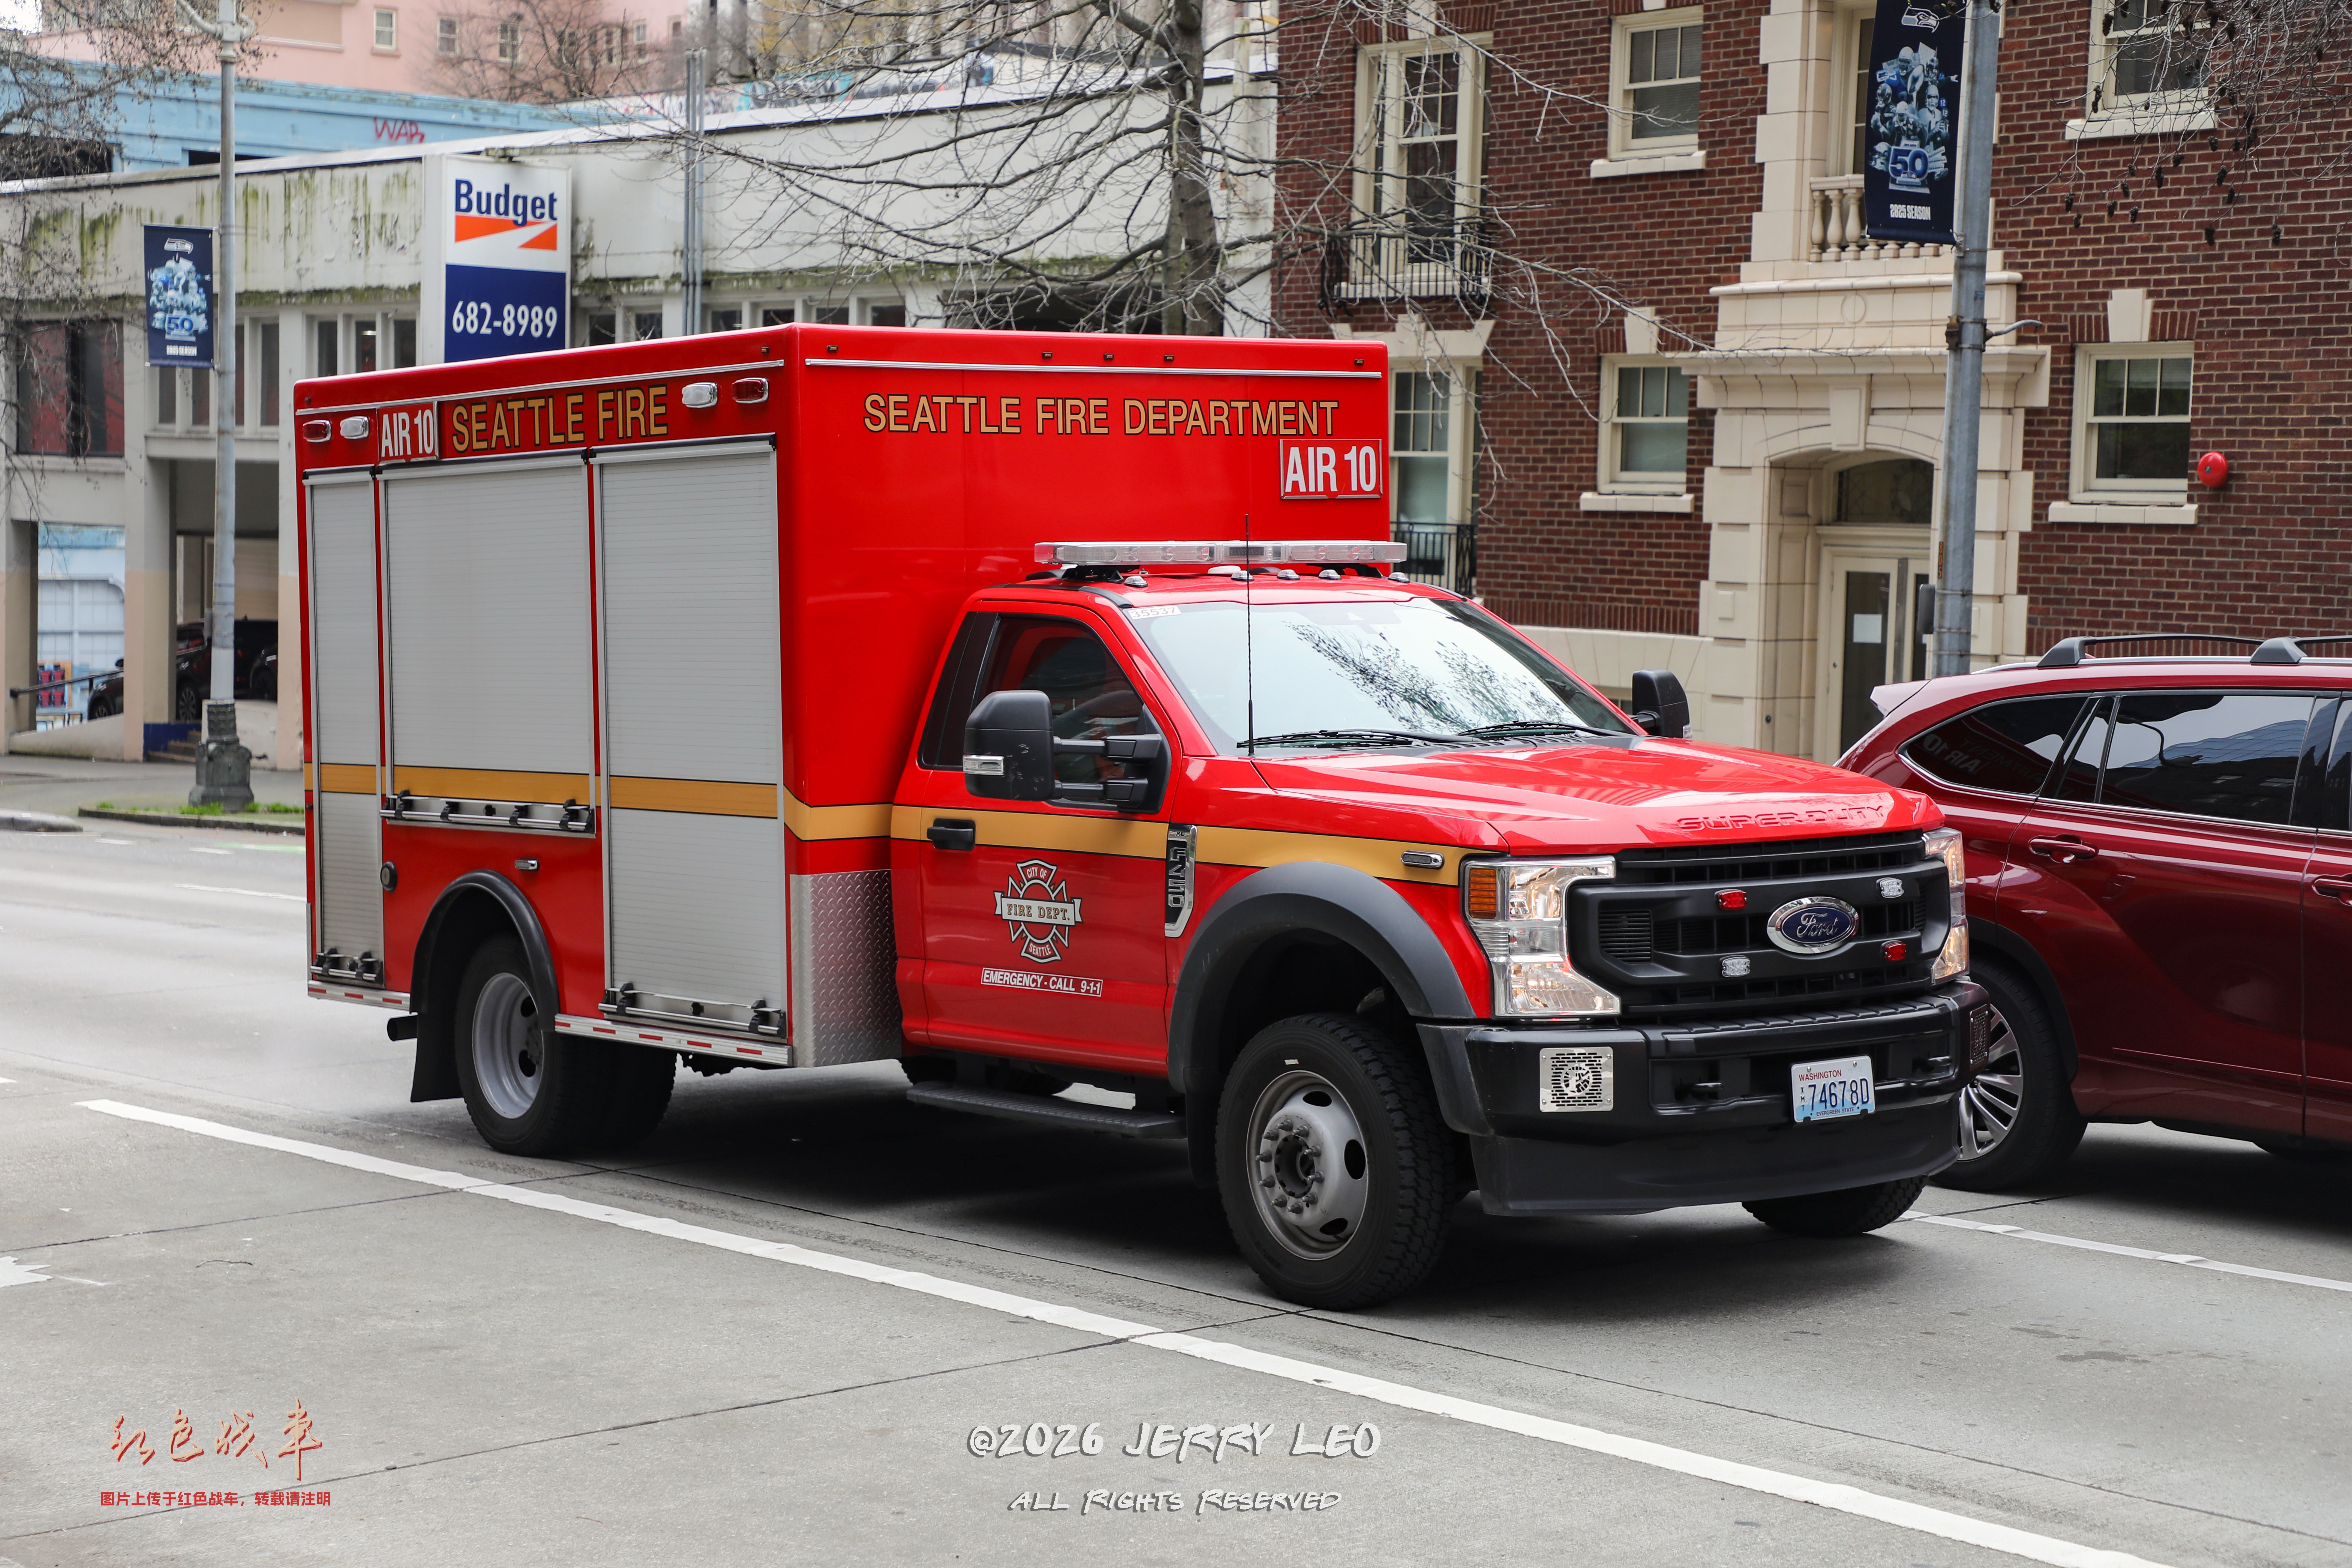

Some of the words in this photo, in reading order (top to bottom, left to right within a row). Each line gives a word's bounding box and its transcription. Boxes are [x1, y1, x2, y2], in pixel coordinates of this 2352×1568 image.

[1890, 148, 1929, 178] 50
[455, 179, 557, 227] Budget
[1890, 204, 1907, 219] 2025
[1907, 205, 1931, 220] SEASON
[167, 317, 193, 331] 50
[452, 301, 558, 338] 682-8989
[451, 392, 585, 454] SEATTLE
[597, 384, 668, 441] FIRE
[863, 393, 1021, 434] SEATTLE
[1036, 397, 1110, 435] FIRE
[1124, 398, 1339, 436] DEPARTMENT
[381, 412, 412, 457] AIR
[414, 409, 435, 454] 10
[1285, 446, 1338, 492] AIR
[1344, 445, 1376, 492] 10
[1131, 607, 1176, 618] 35537
[1677, 812, 1805, 831] SUPER
[1805, 805, 1883, 824] DUTY
[1027, 866, 1038, 878] CITY
[1040, 868, 1047, 879] OF
[1007, 904, 1032, 917] FIRE
[1038, 906, 1070, 921] DEPT.
[1797, 913, 1838, 938] Ford
[1029, 943, 1051, 957] SEATTLE
[983, 970, 1043, 988] EMERGENCY
[1049, 976, 1075, 992] CALL
[1081, 980, 1101, 994] 9-1-1
[1799, 1070, 1842, 1081] WASHINGTON
[1808, 1078, 1869, 1111] 74678D
